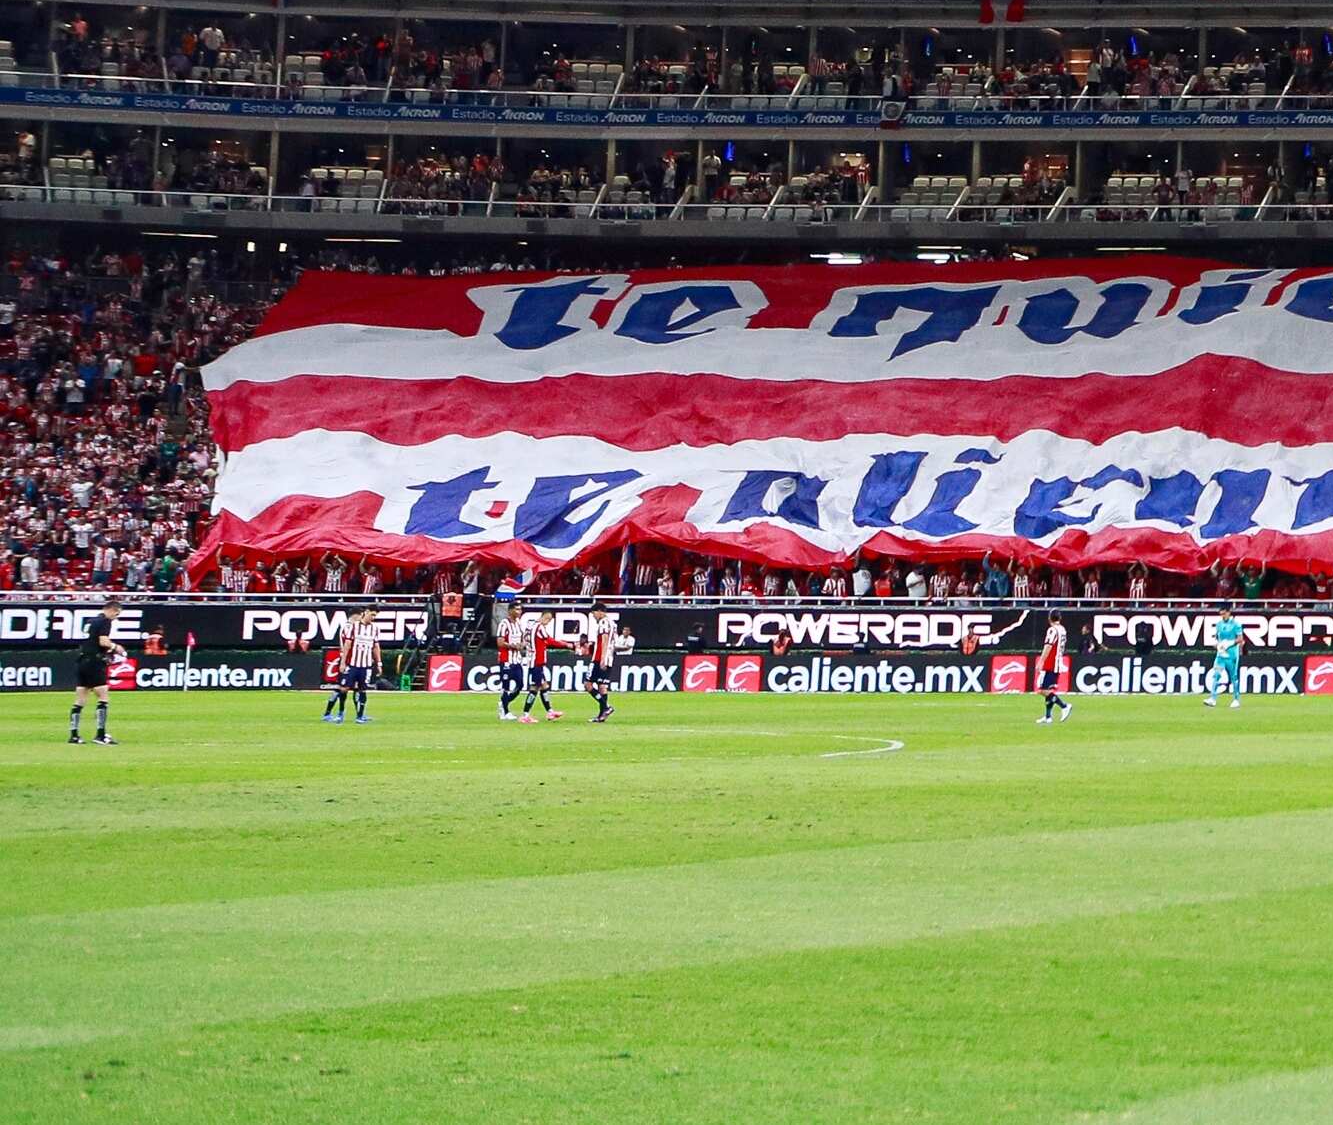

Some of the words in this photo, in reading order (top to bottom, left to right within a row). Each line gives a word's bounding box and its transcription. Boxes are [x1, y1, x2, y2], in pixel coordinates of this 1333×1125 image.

[26, 91, 71, 103] Estadio
[135, 96, 177, 109] Estadio
[241, 101, 285, 114] Estadio
[348, 105, 390, 118] Estadio
[452, 108, 495, 121] Estadio
[556, 111, 598, 123] Estadio
[657, 112, 698, 123] Estadio
[757, 113, 797, 124] Estadio
[955, 114, 996, 125] Estadio
[1053, 114, 1093, 125] Estadio
[1150, 114, 1190, 125] Estadio
[1248, 114, 1289, 125] Estadio
[494, 277, 742, 350] te
[404, 466, 643, 549] te
[136, 663, 292, 688] caliente.mx
[767, 657, 984, 692] caliente.mx
